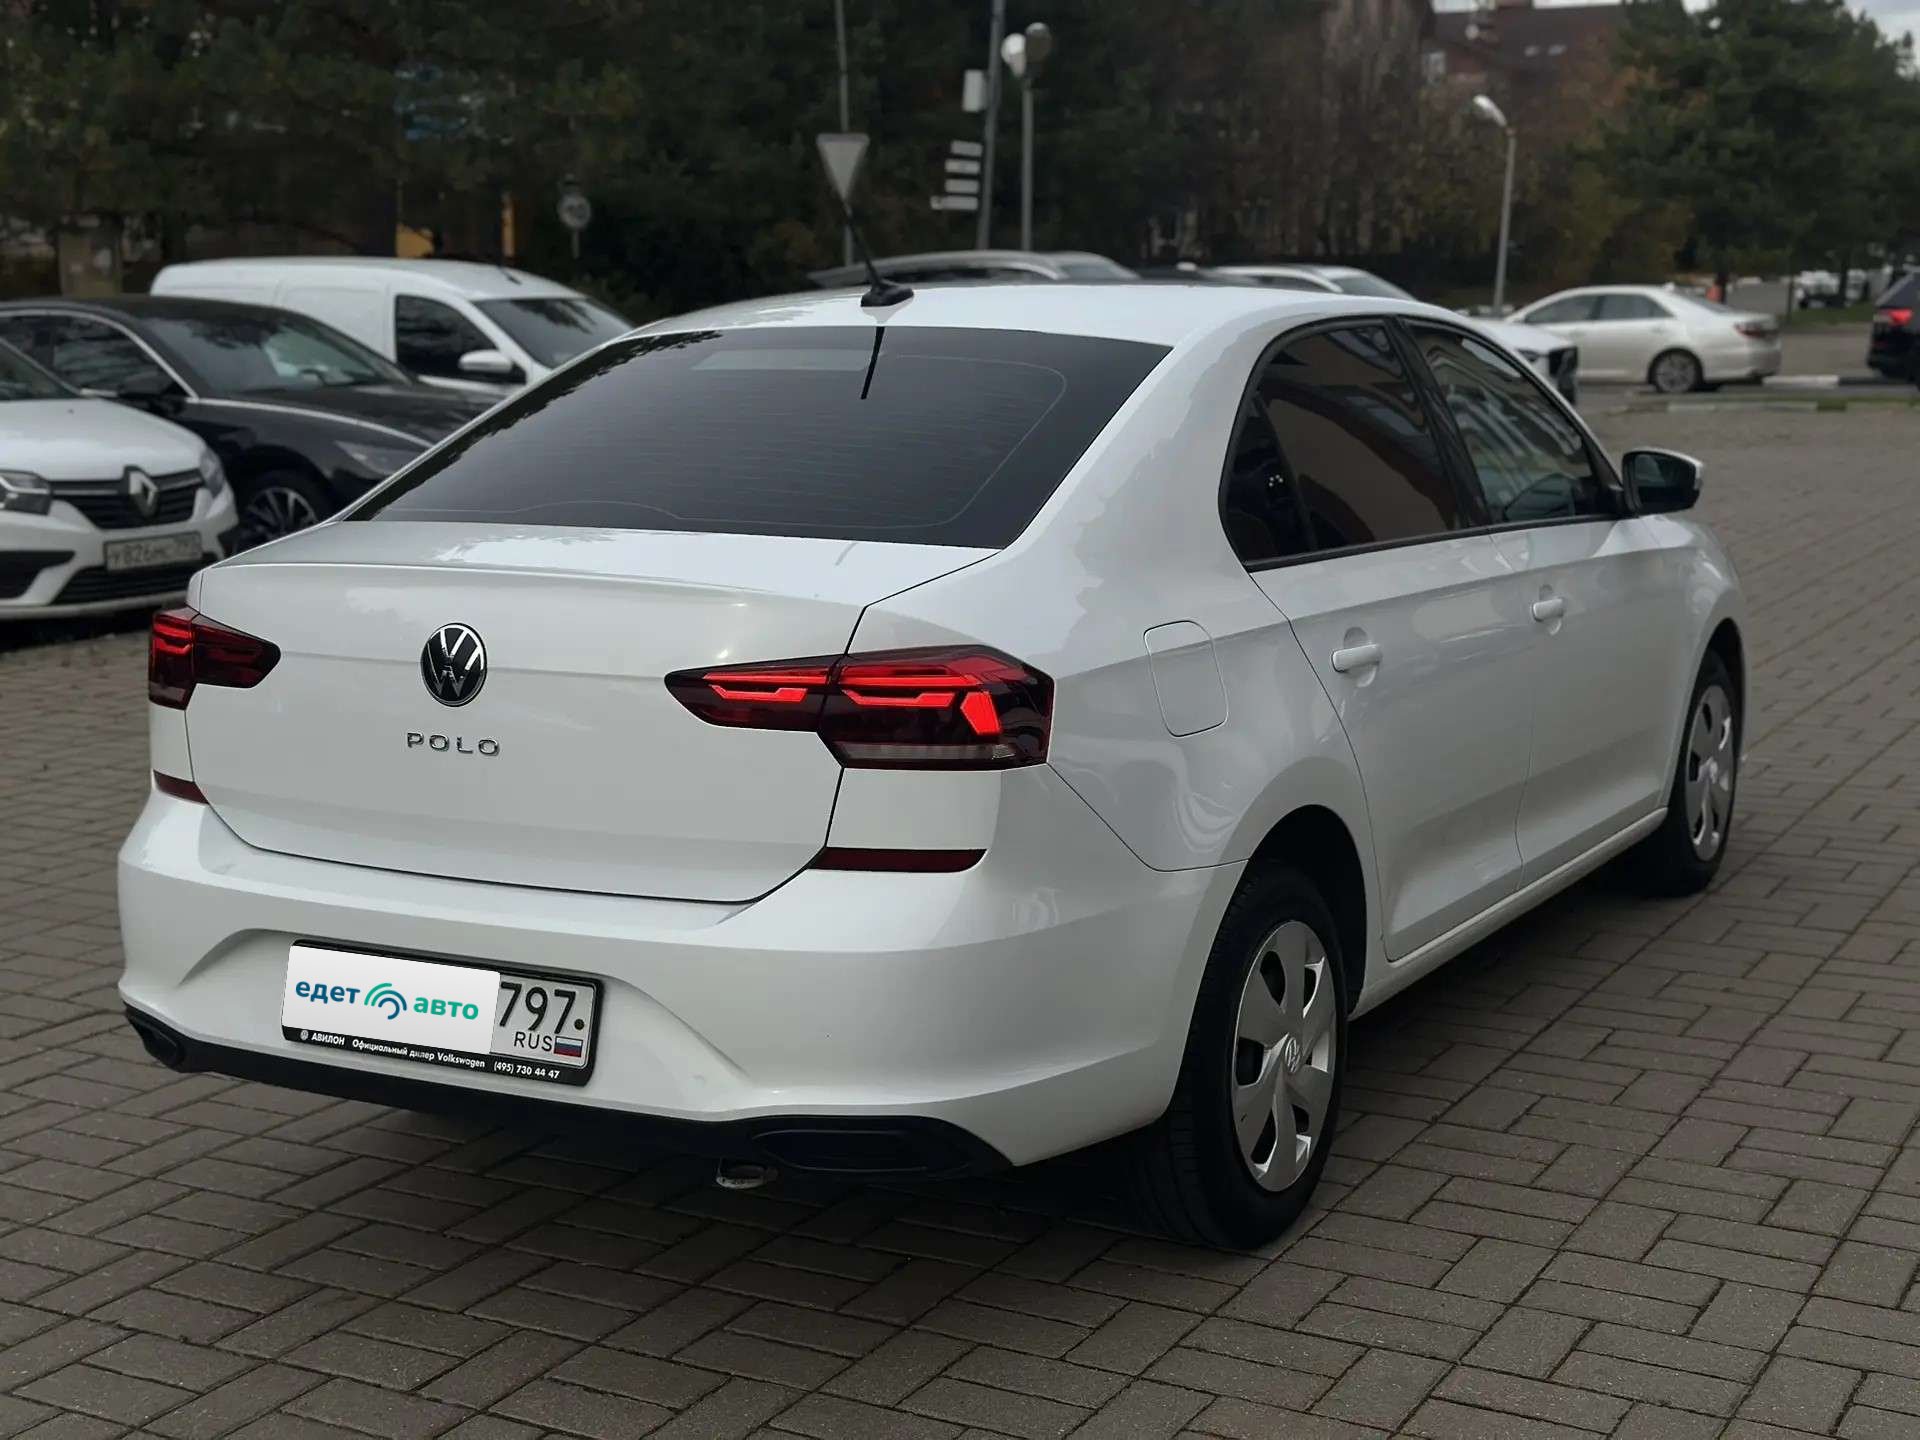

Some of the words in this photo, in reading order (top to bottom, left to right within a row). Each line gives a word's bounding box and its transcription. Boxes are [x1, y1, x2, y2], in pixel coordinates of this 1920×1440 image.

[406, 732, 500, 756] POLO
[499, 981, 576, 1035] 797
[311, 1032, 345, 1046] АВИЛОН
[513, 1031, 553, 1052] RUS
[352, 1038, 408, 1056] Официальный
[437, 1051, 486, 1069] Volkswagen
[493, 1061, 514, 1074] (495)
[516, 1064, 532, 1076] 730
[534, 1067, 546, 1077] 44
[548, 1069, 560, 1080] 47
